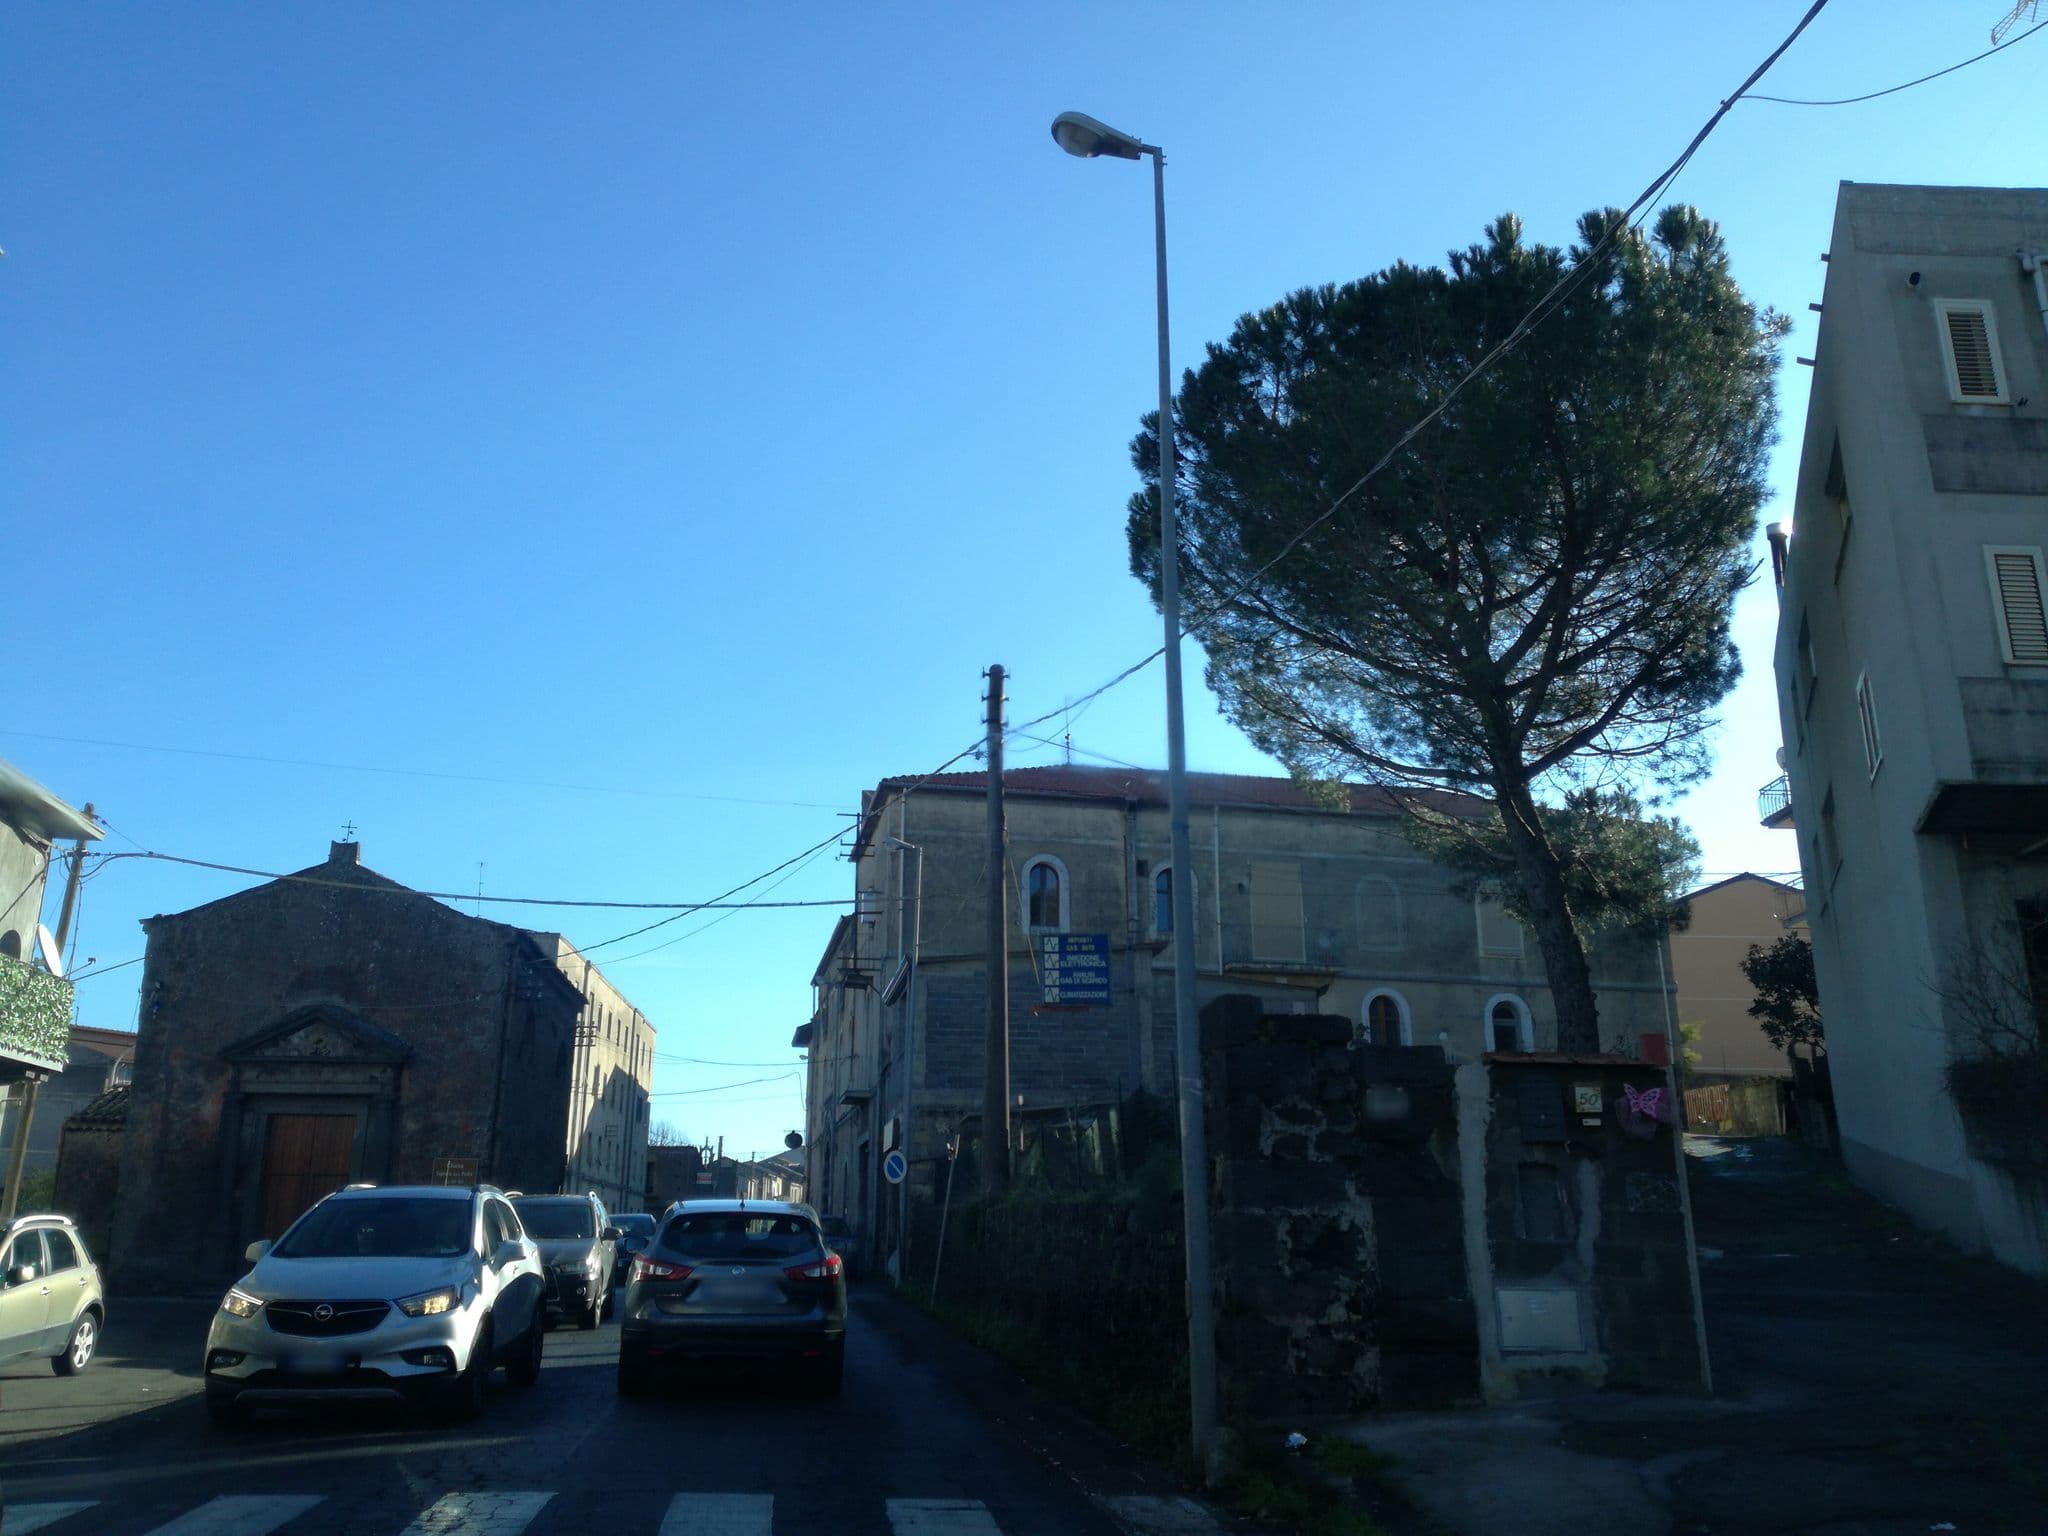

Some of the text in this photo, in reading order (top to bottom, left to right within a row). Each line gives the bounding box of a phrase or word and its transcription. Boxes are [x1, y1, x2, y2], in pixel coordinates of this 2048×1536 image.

[1060, 960, 1106, 968] ELETTRONICA
[1059, 991, 1108, 999] CLIMATIZZAZIONE
[1579, 1093, 1599, 1106] 50
